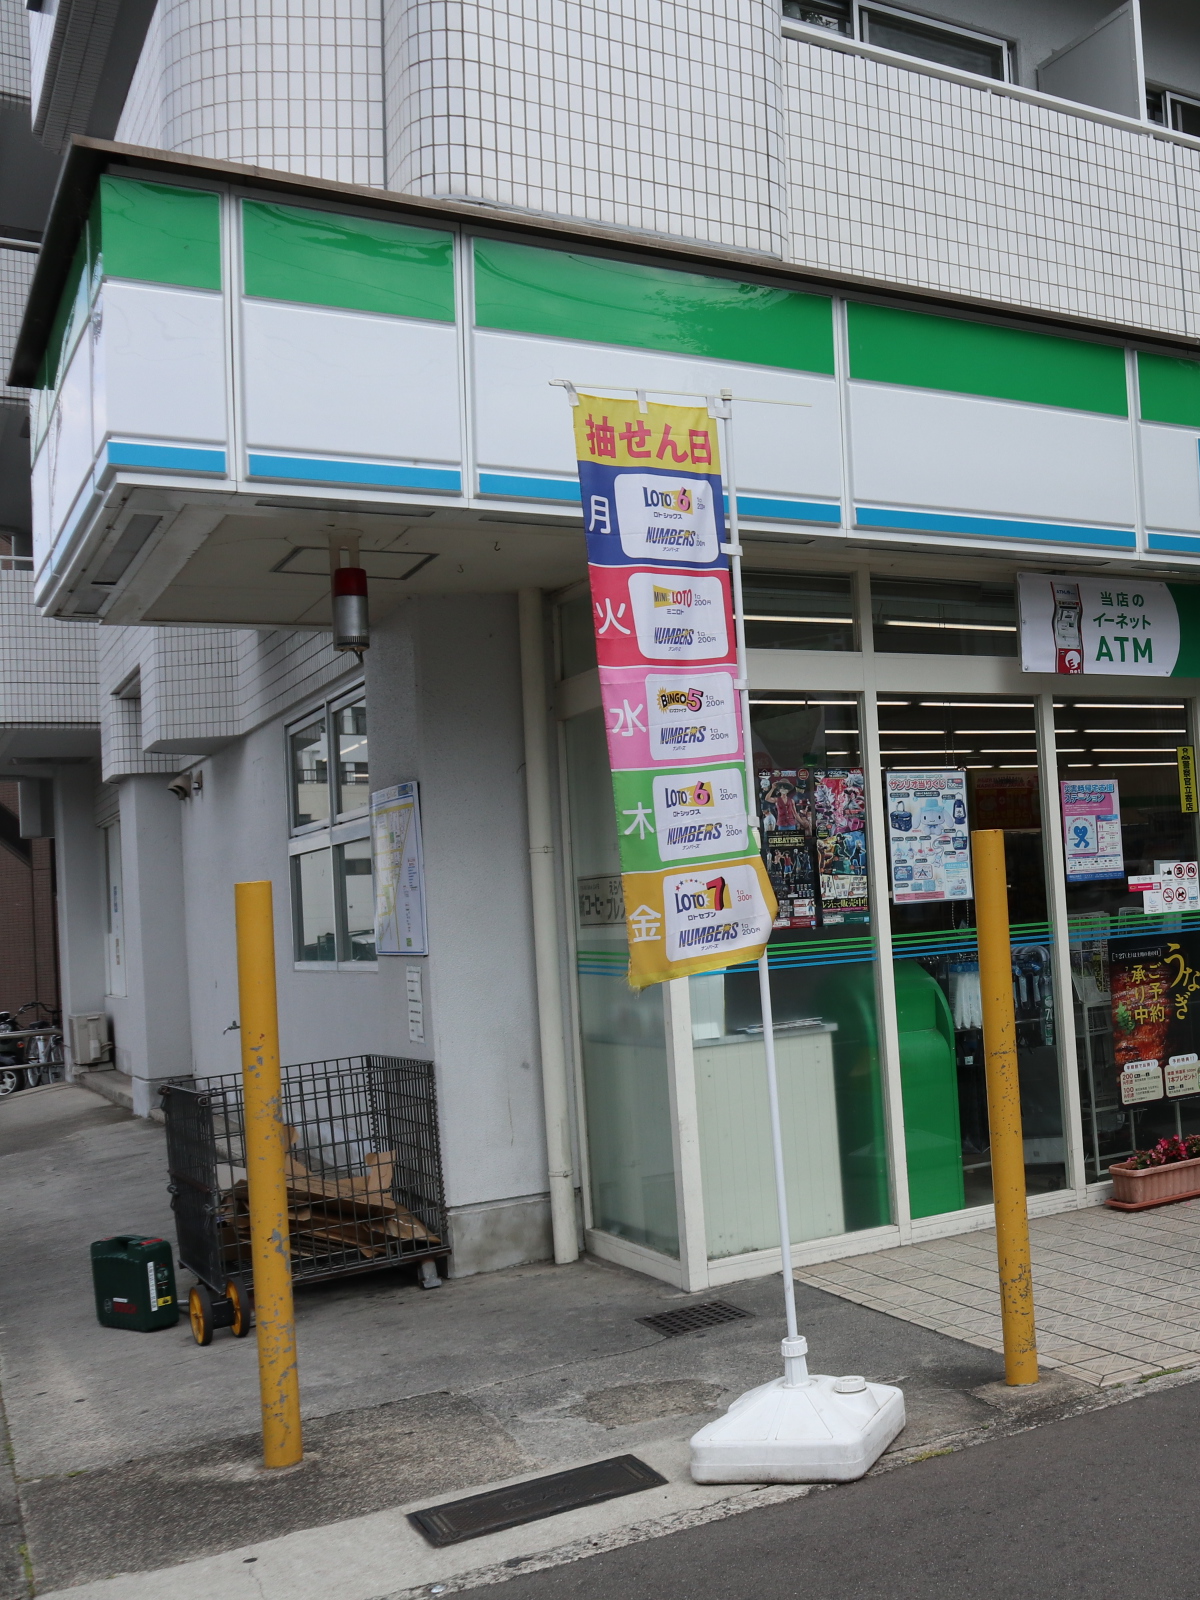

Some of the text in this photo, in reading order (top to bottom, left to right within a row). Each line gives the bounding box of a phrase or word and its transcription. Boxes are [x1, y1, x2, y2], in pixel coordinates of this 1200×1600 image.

[585, 413, 712, 466] 抽せん日
[643, 486, 672, 508] LOTO
[676, 487, 691, 511] 6
[589, 494, 612, 534] 月
[653, 511, 683, 520] ロトシックス
[646, 526, 696, 547] NUMBERS
[654, 589, 692, 608] MINI LOTO
[1100, 591, 1145, 608] 当店の
[595, 597, 631, 635] 火
[1093, 613, 1152, 631] イーネット
[654, 626, 694, 646] NUMBERS
[1095, 636, 1153, 664] ATM
[660, 688, 704, 712] BINGO 5
[706, 699, 725, 708] 200円
[609, 699, 647, 737] 水
[660, 725, 707, 745] NUMBERS
[710, 732, 729, 740] 200円
[665, 781, 710, 809] LOTO 6
[889, 779, 946, 791] サンリオ当りくじ
[720, 793, 738, 801] 200円
[1064, 794, 1106, 804] ステーション
[622, 801, 655, 840] 木
[672, 810, 702, 818] ロトシックス
[666, 822, 723, 846] NUMBERS
[725, 828, 743, 837] 200円
[674, 876, 726, 915] LOTO 7
[629, 904, 662, 943] 金
[687, 911, 717, 921] ロトセブン
[678, 921, 739, 948] NUMBERS
[742, 927, 761, 935] 200円
[1164, 942, 1200, 1020] うなぎ
[1131, 964, 1150, 1025] 承り中
[1148, 962, 1166, 1023] ご予約
